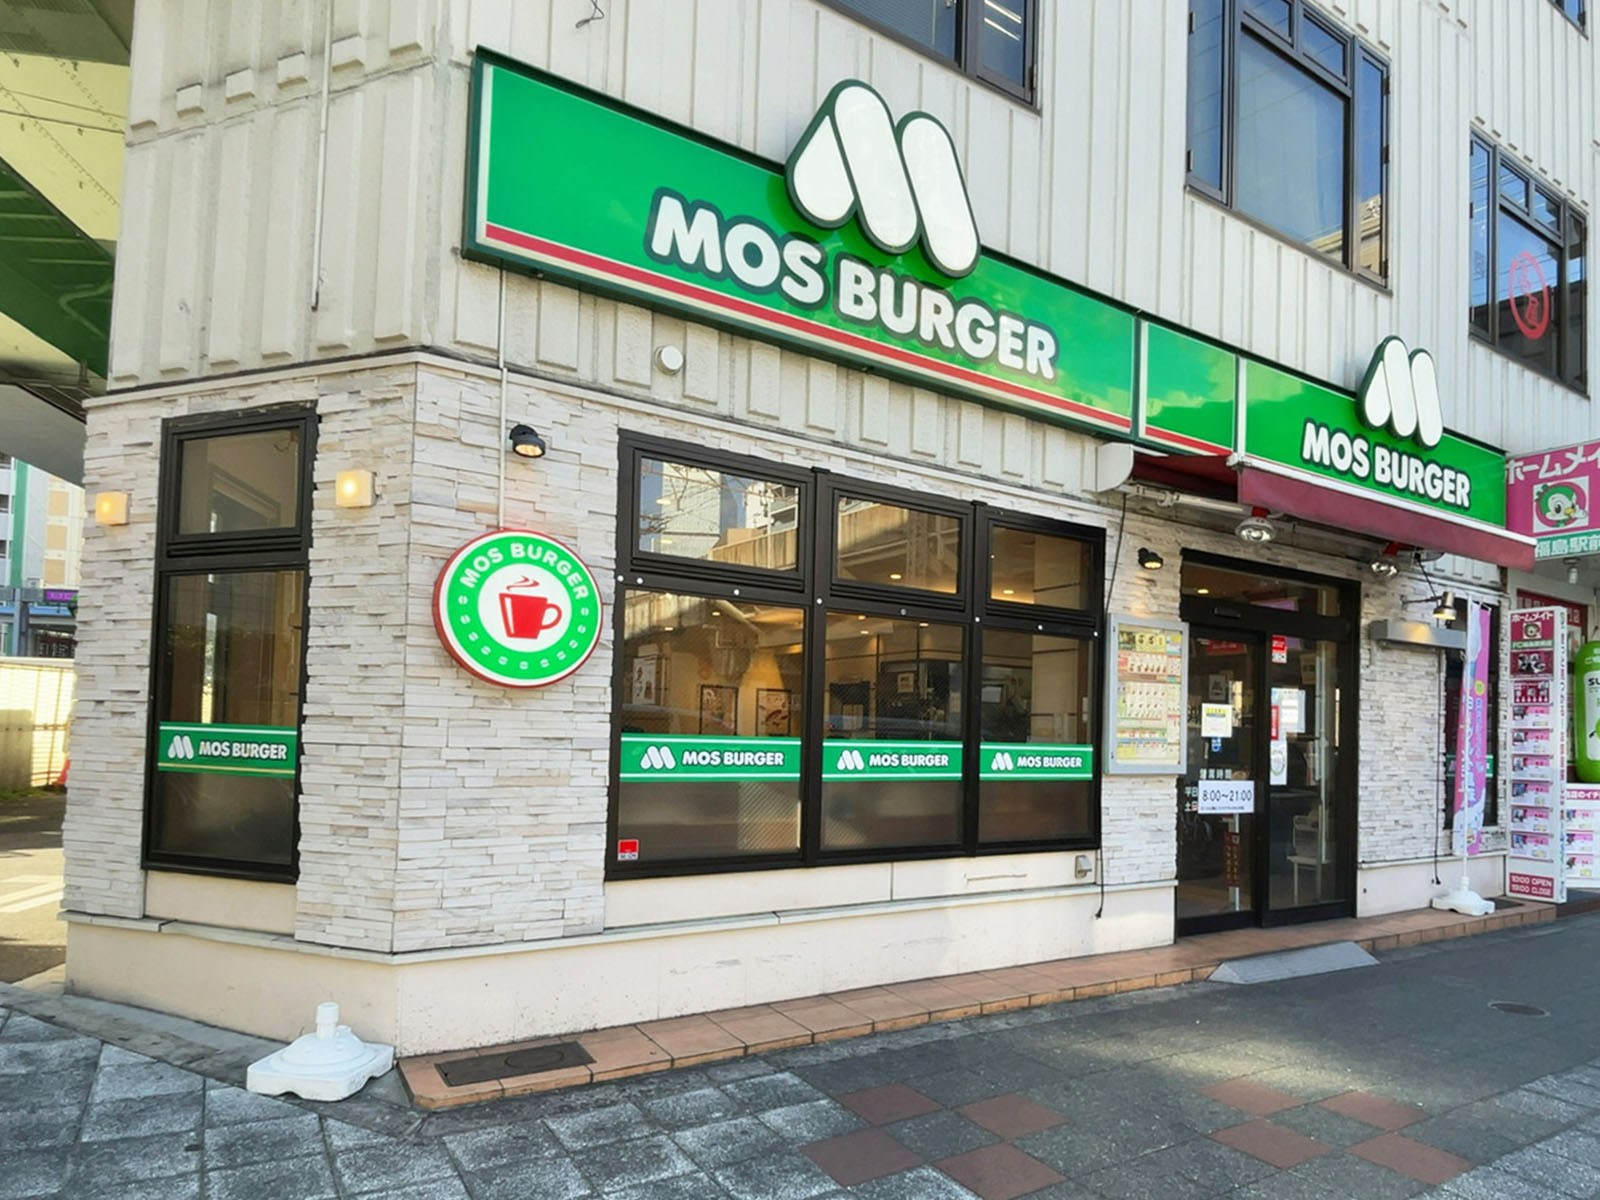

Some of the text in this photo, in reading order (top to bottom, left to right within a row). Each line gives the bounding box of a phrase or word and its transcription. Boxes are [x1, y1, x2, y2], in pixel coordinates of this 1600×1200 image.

[651, 195, 1057, 379] MOS BURGER
[1302, 422, 1470, 508] MOS BURGER
[459, 543, 589, 600] MOS BURGER
[199, 741, 230, 757] MOS
[232, 743, 287, 760] BURGER
[682, 751, 721, 766] MOS
[723, 751, 784, 766] BURGER
[869, 753, 900, 767] MOS
[901, 754, 949, 767] BURGER
[1017, 755, 1042, 768] MOS
[1043, 756, 1082, 769] BURGER
